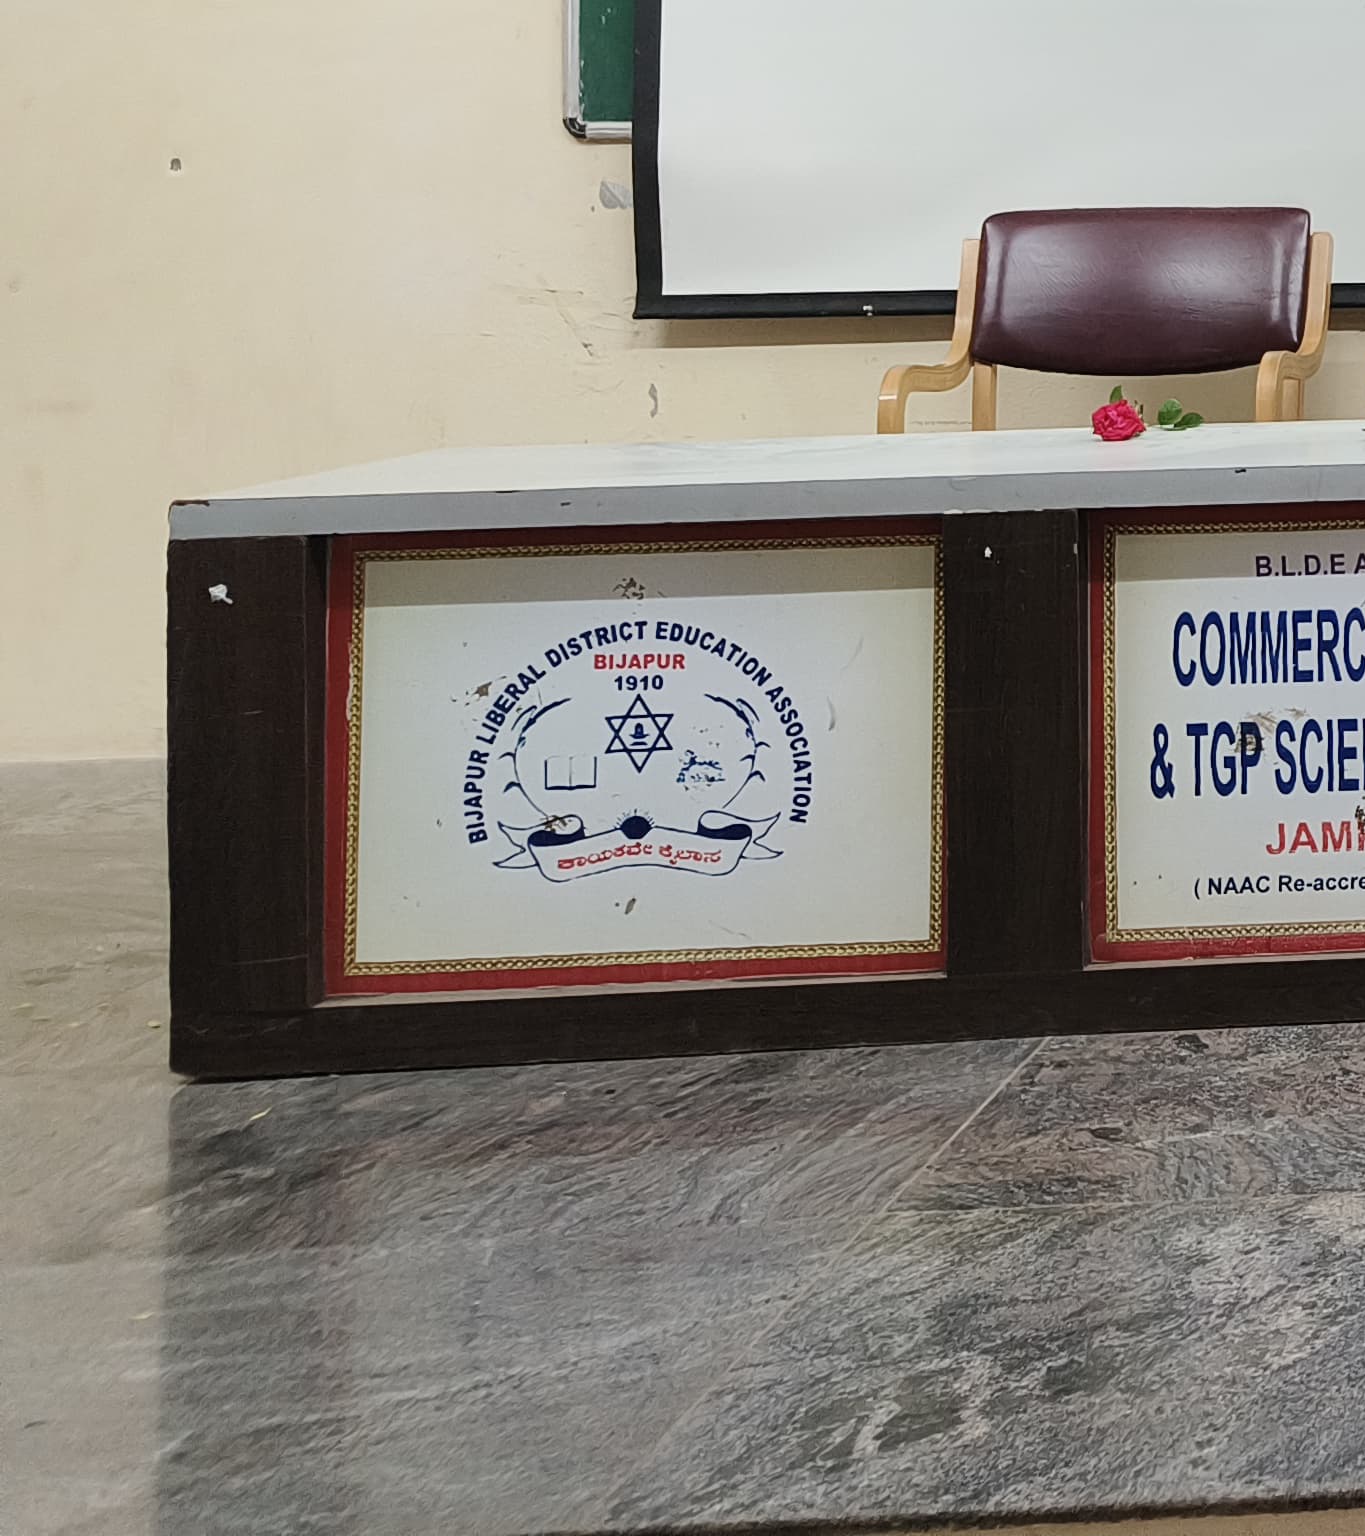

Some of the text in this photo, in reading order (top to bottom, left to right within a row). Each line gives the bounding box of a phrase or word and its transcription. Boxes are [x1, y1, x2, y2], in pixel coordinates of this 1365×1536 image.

[1254, 553, 1347, 578] B.L.D.E
[592, 653, 686, 671] BIJAPUR
[613, 674, 665, 692] 1910
[463, 620, 813, 846] BIJAPUR LIBERAL DISTRICT EDUCATION ASSOCIATION
[1149, 722, 1175, 800] &
[1186, 720, 1264, 798] TGP
[658, 844, 722, 866] ಕೈಲಾಸ
[1206, 873, 1272, 897] NAAC
